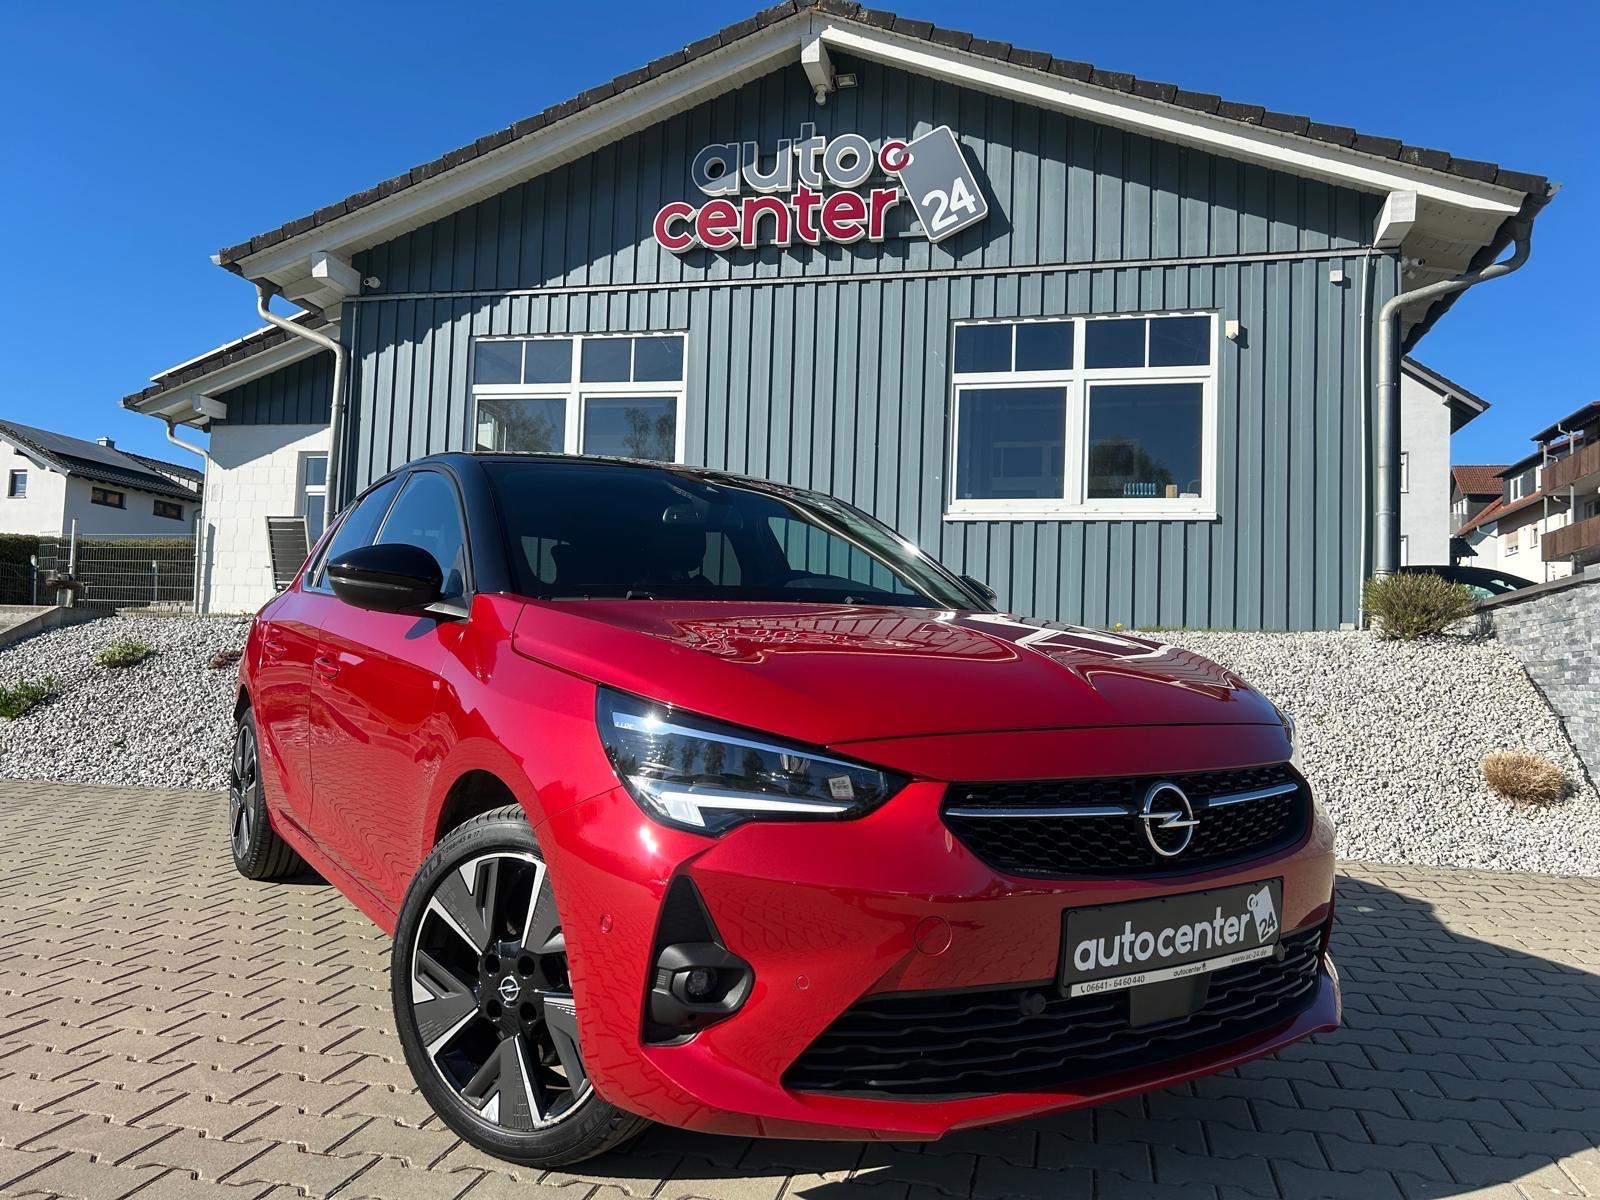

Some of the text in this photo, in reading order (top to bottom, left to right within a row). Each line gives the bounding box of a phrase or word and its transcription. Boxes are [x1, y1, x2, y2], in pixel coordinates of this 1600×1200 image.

[691, 122, 874, 196] auto
[653, 183, 899, 253] center
[921, 177, 976, 231] 24
[1073, 906, 1276, 971] autocenter 24
[1086, 980, 1108, 993] 06641
